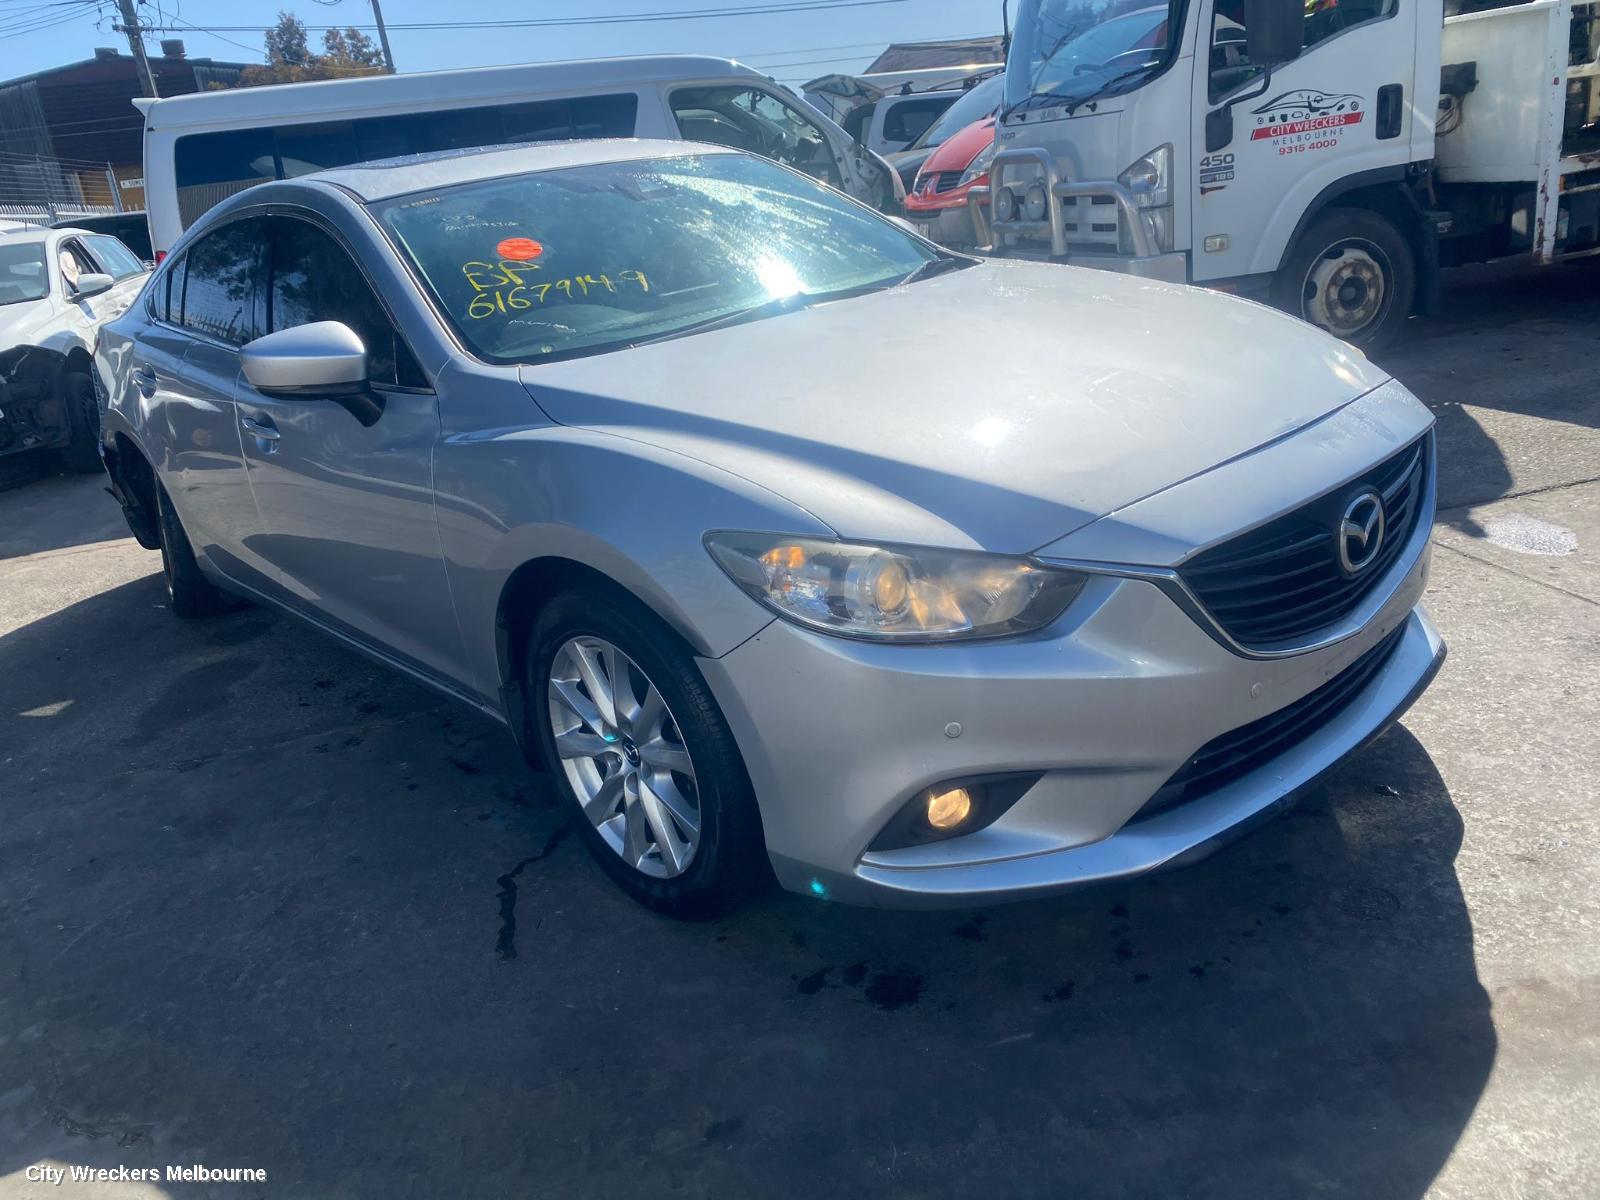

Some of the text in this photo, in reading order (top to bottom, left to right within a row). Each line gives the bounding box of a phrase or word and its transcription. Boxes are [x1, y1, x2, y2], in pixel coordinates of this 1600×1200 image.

[1270, 115, 1346, 136] CITY WRECKERS
[1272, 128, 1345, 146] MELBOURNE
[1279, 139, 1337, 155] 9315 4000
[1199, 153, 1234, 167] 450
